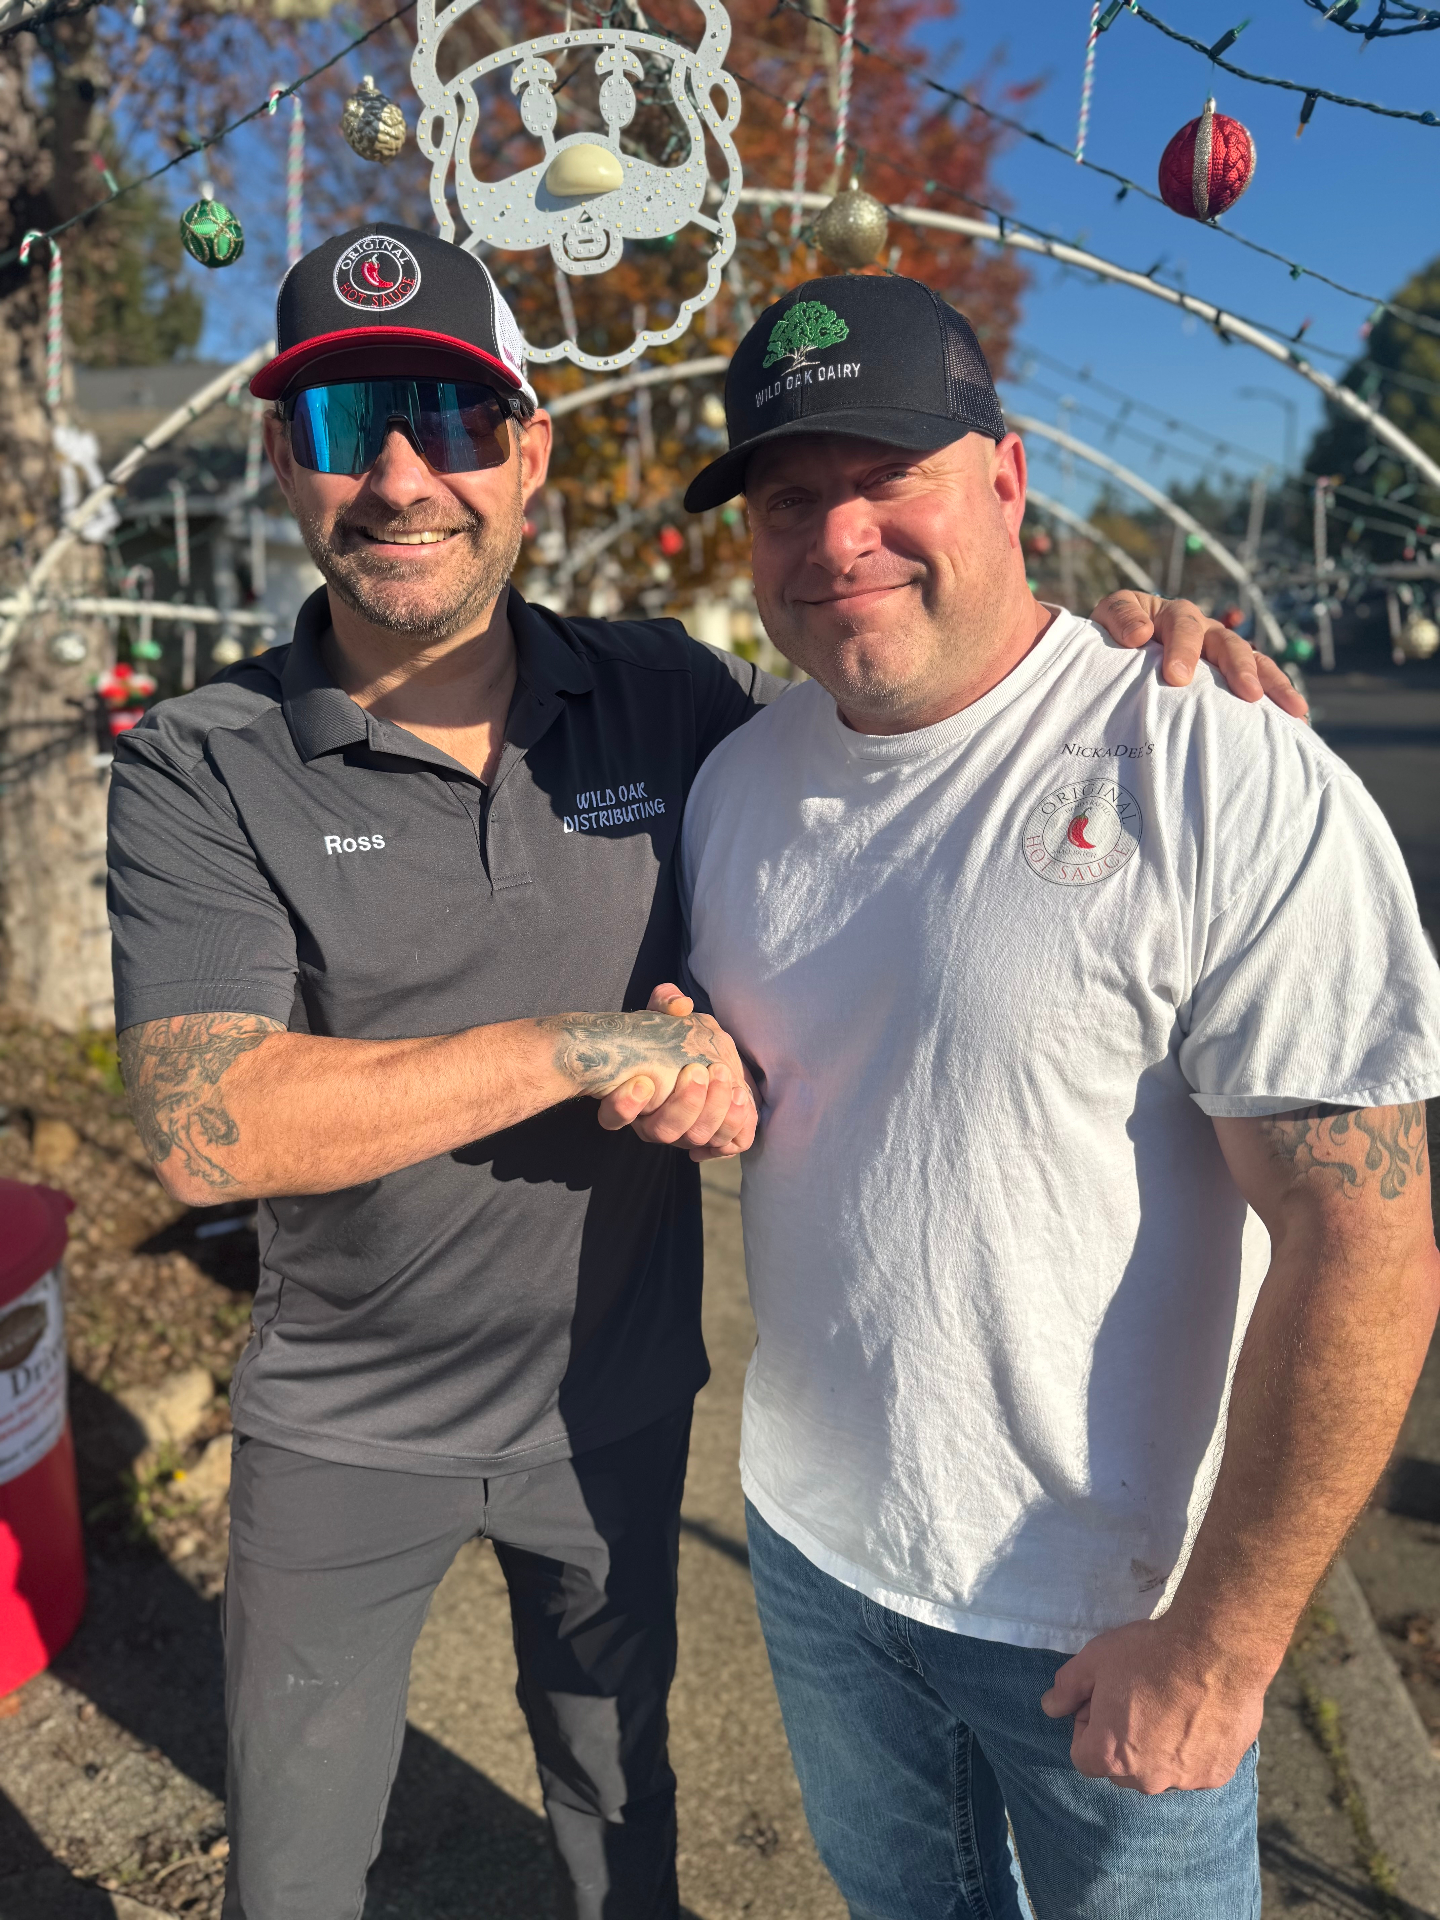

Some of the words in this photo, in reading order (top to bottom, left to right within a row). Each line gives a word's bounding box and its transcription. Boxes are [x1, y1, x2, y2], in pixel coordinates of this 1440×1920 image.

[341, 240, 409, 270] ORIGINAL
[339, 282, 367, 305] HOT
[371, 276, 416, 307] SAUCE
[755, 381, 781, 408] WILD
[786, 369, 813, 390] OAK
[817, 362, 861, 381] DAIRY
[576, 788, 616, 810] WILD
[618, 781, 648, 802] OAK
[1041, 782, 1137, 825] ORIGINAL
[563, 798, 666, 834] DISTRIBUTING
[323, 834, 386, 856] Ross
[1026, 834, 1053, 872] HOT
